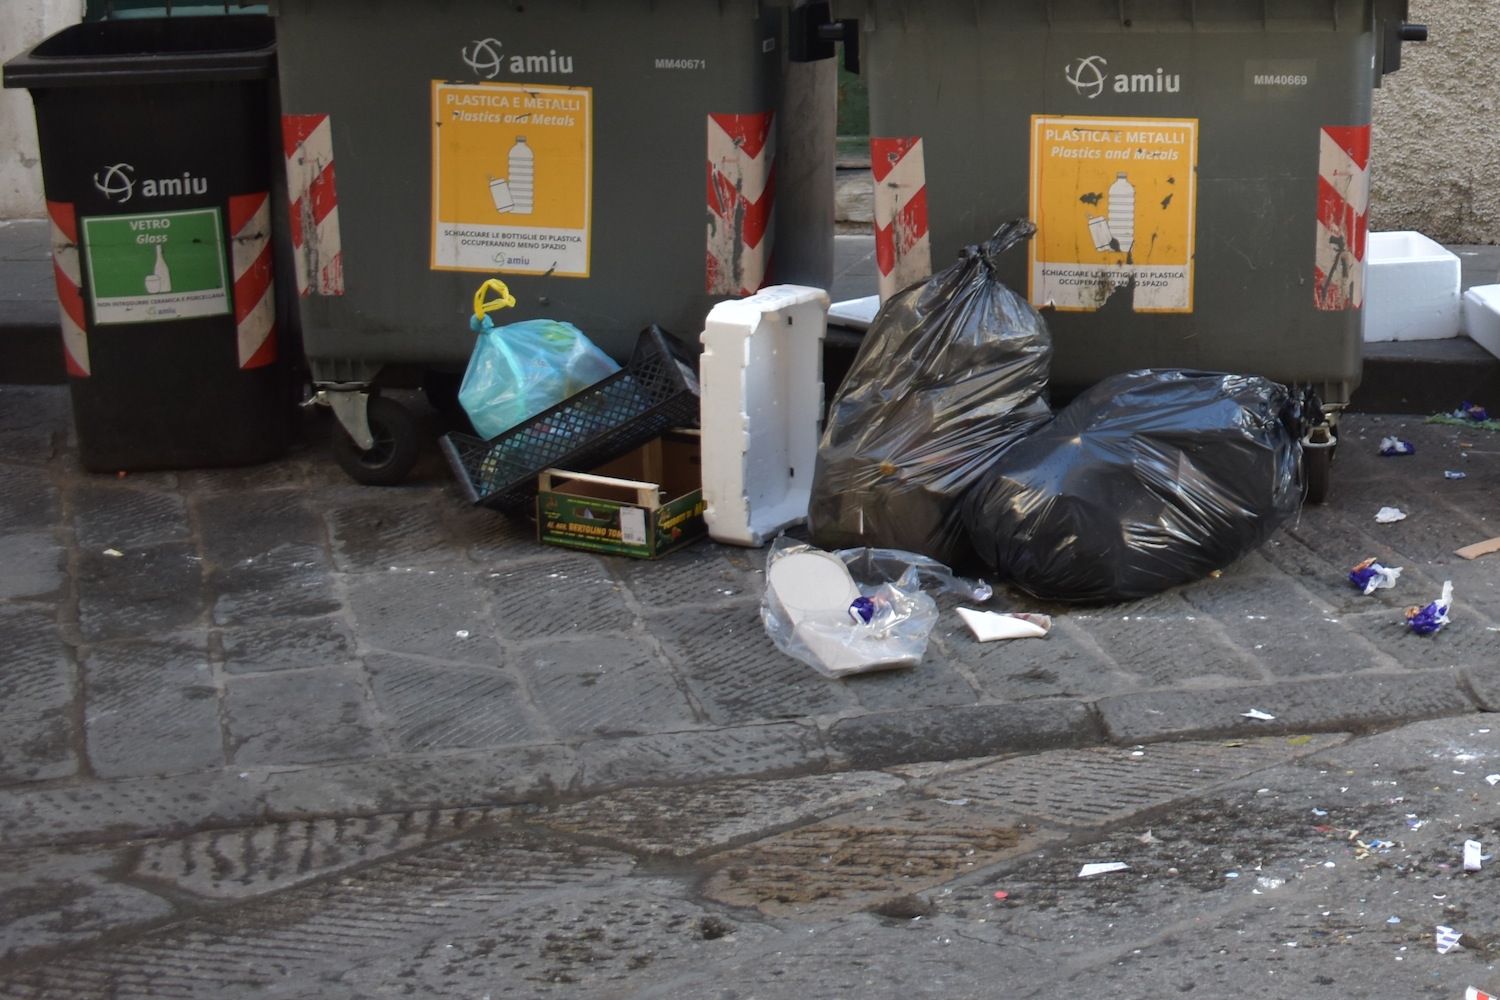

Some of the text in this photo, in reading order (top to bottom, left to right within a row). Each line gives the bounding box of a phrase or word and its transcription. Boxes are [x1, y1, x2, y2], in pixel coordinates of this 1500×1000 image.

[509, 50, 574, 74] amiu
[655, 58, 706, 69] MM40671
[1113, 68, 1181, 93] amiu
[1254, 75, 1308, 86] MM40669
[446, 94, 580, 111] PLASTICA E METALLI
[452, 110, 575, 127] Plastics and Metals
[1045, 130, 1185, 144] PLASTICA E METALLI
[1051, 146, 1179, 161] Plastics and Metals
[142, 171, 208, 197] amiu
[130, 218, 171, 231] VETRO
[136, 234, 168, 245] Glass
[444, 230, 490, 239] SCHIACCIARE
[502, 232, 537, 240] BOTTIGLIE
[548, 234, 582, 243] PLASTICA
[461, 239, 516, 248] OCCUPERANNO
[506, 255, 530, 265] amiu
[1041, 269, 1089, 278] SCHIACCIARE
[186, 293, 225, 301] PORCELLANA
[568, 522, 607, 536] BERTOLINO
